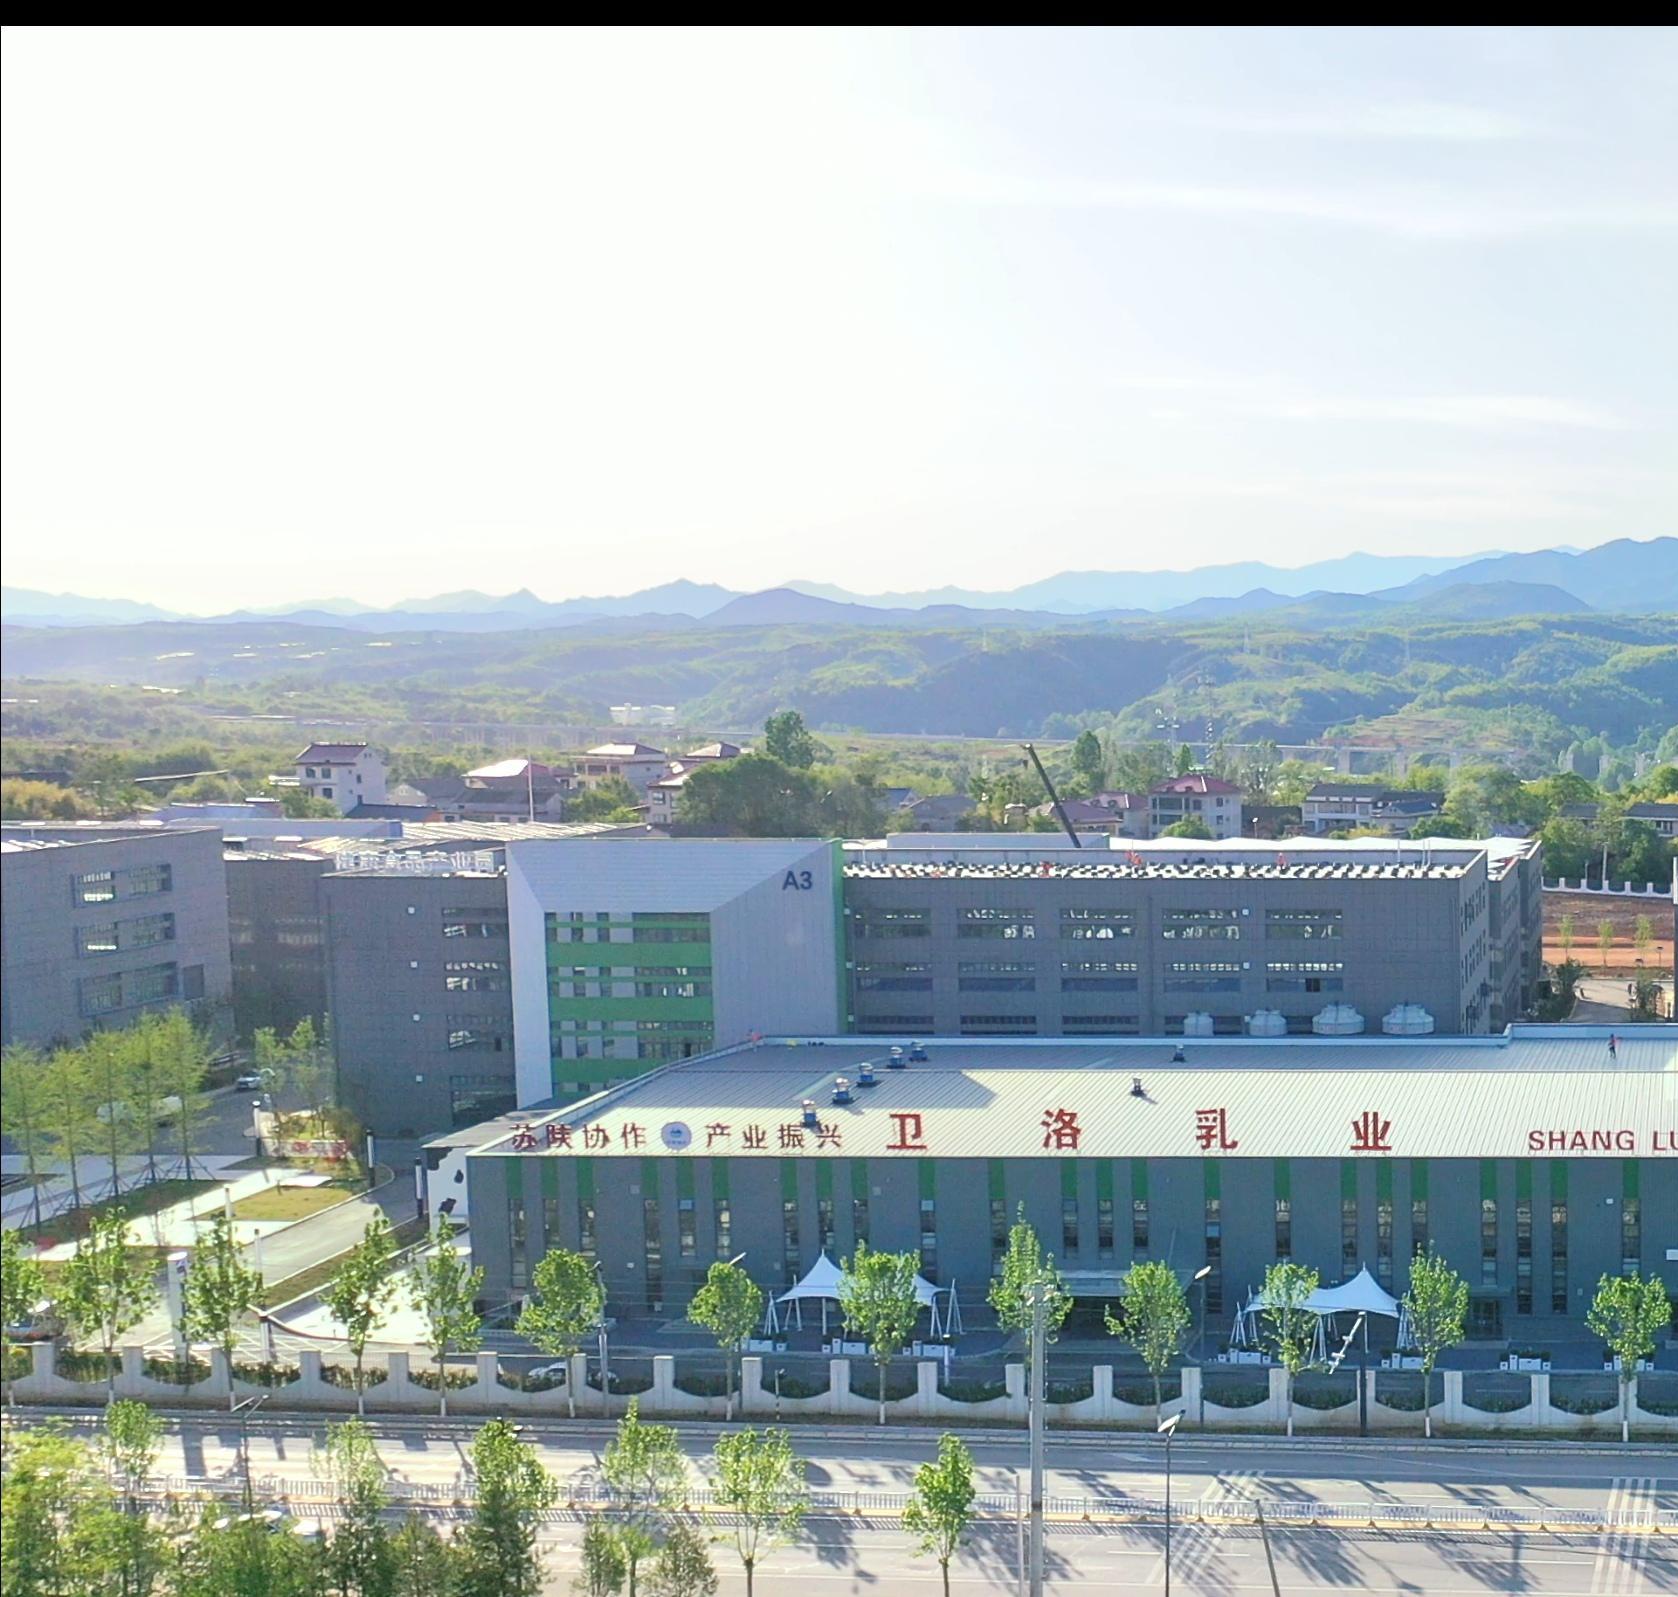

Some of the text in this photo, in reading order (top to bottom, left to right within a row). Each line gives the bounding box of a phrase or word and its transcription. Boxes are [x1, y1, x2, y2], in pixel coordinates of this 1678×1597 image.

[783, 870, 813, 891] A3
[509, 1122, 842, 1149] 苏陕协作 产业振兴
[886, 1108, 1393, 1152] 卫洛乳业
[1528, 1130, 1635, 1151] SHANG
